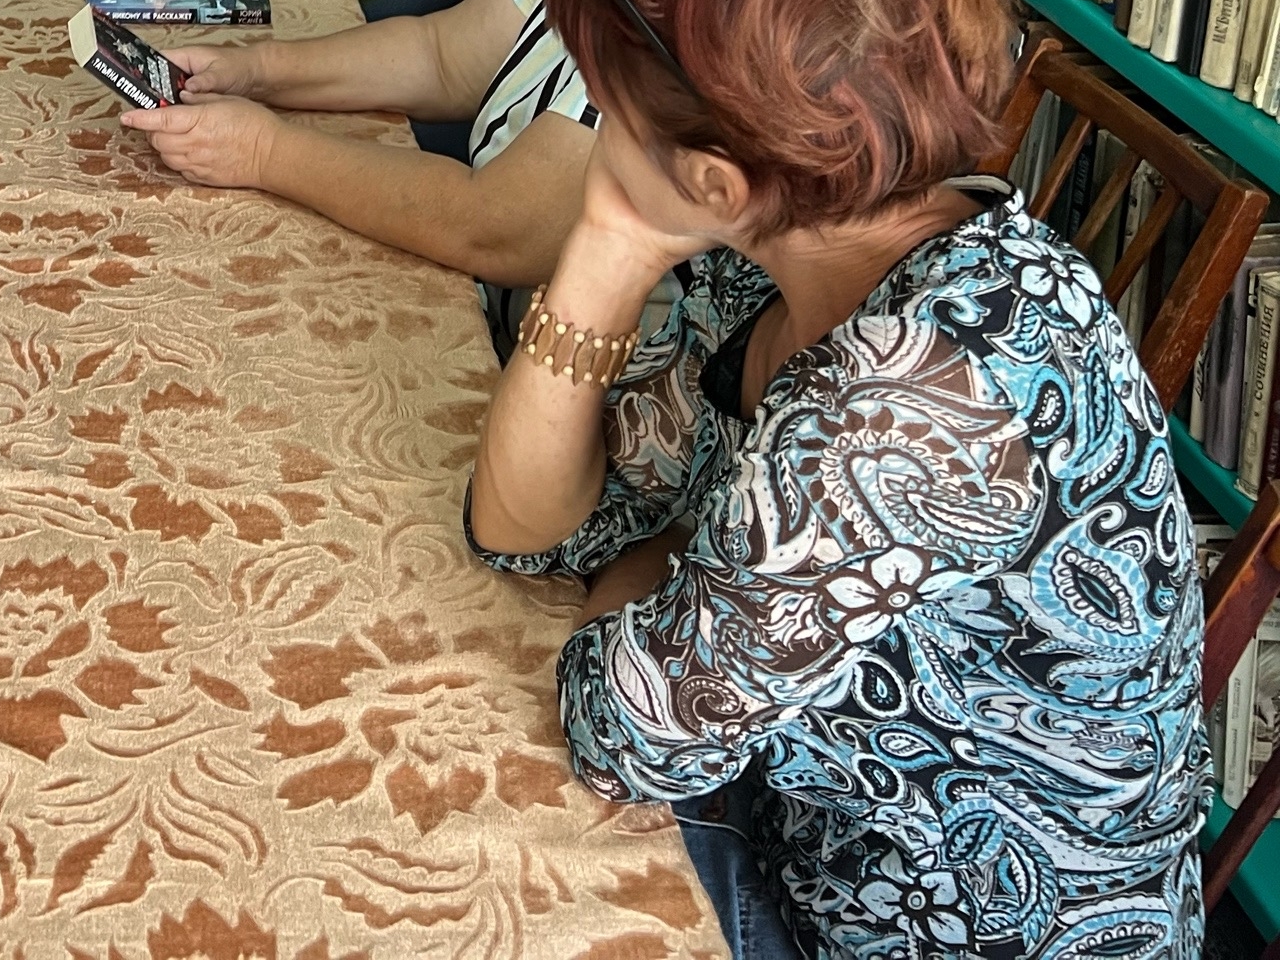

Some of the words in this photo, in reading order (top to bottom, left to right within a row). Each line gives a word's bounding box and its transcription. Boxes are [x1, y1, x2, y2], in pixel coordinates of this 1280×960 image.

[111, 11, 141, 21] НИКОМУ
[142, 12, 151, 20] НЕ
[152, 12, 193, 21] РАССКАЖЕТ
[239, 9, 262, 17] ЮРИЙ
[92, 57, 119, 83] ТАТЬЯНА
[116, 76, 158, 110] СТЕПАНОВА
[1253, 305, 1275, 402] СОЧИНЕНИЯ
